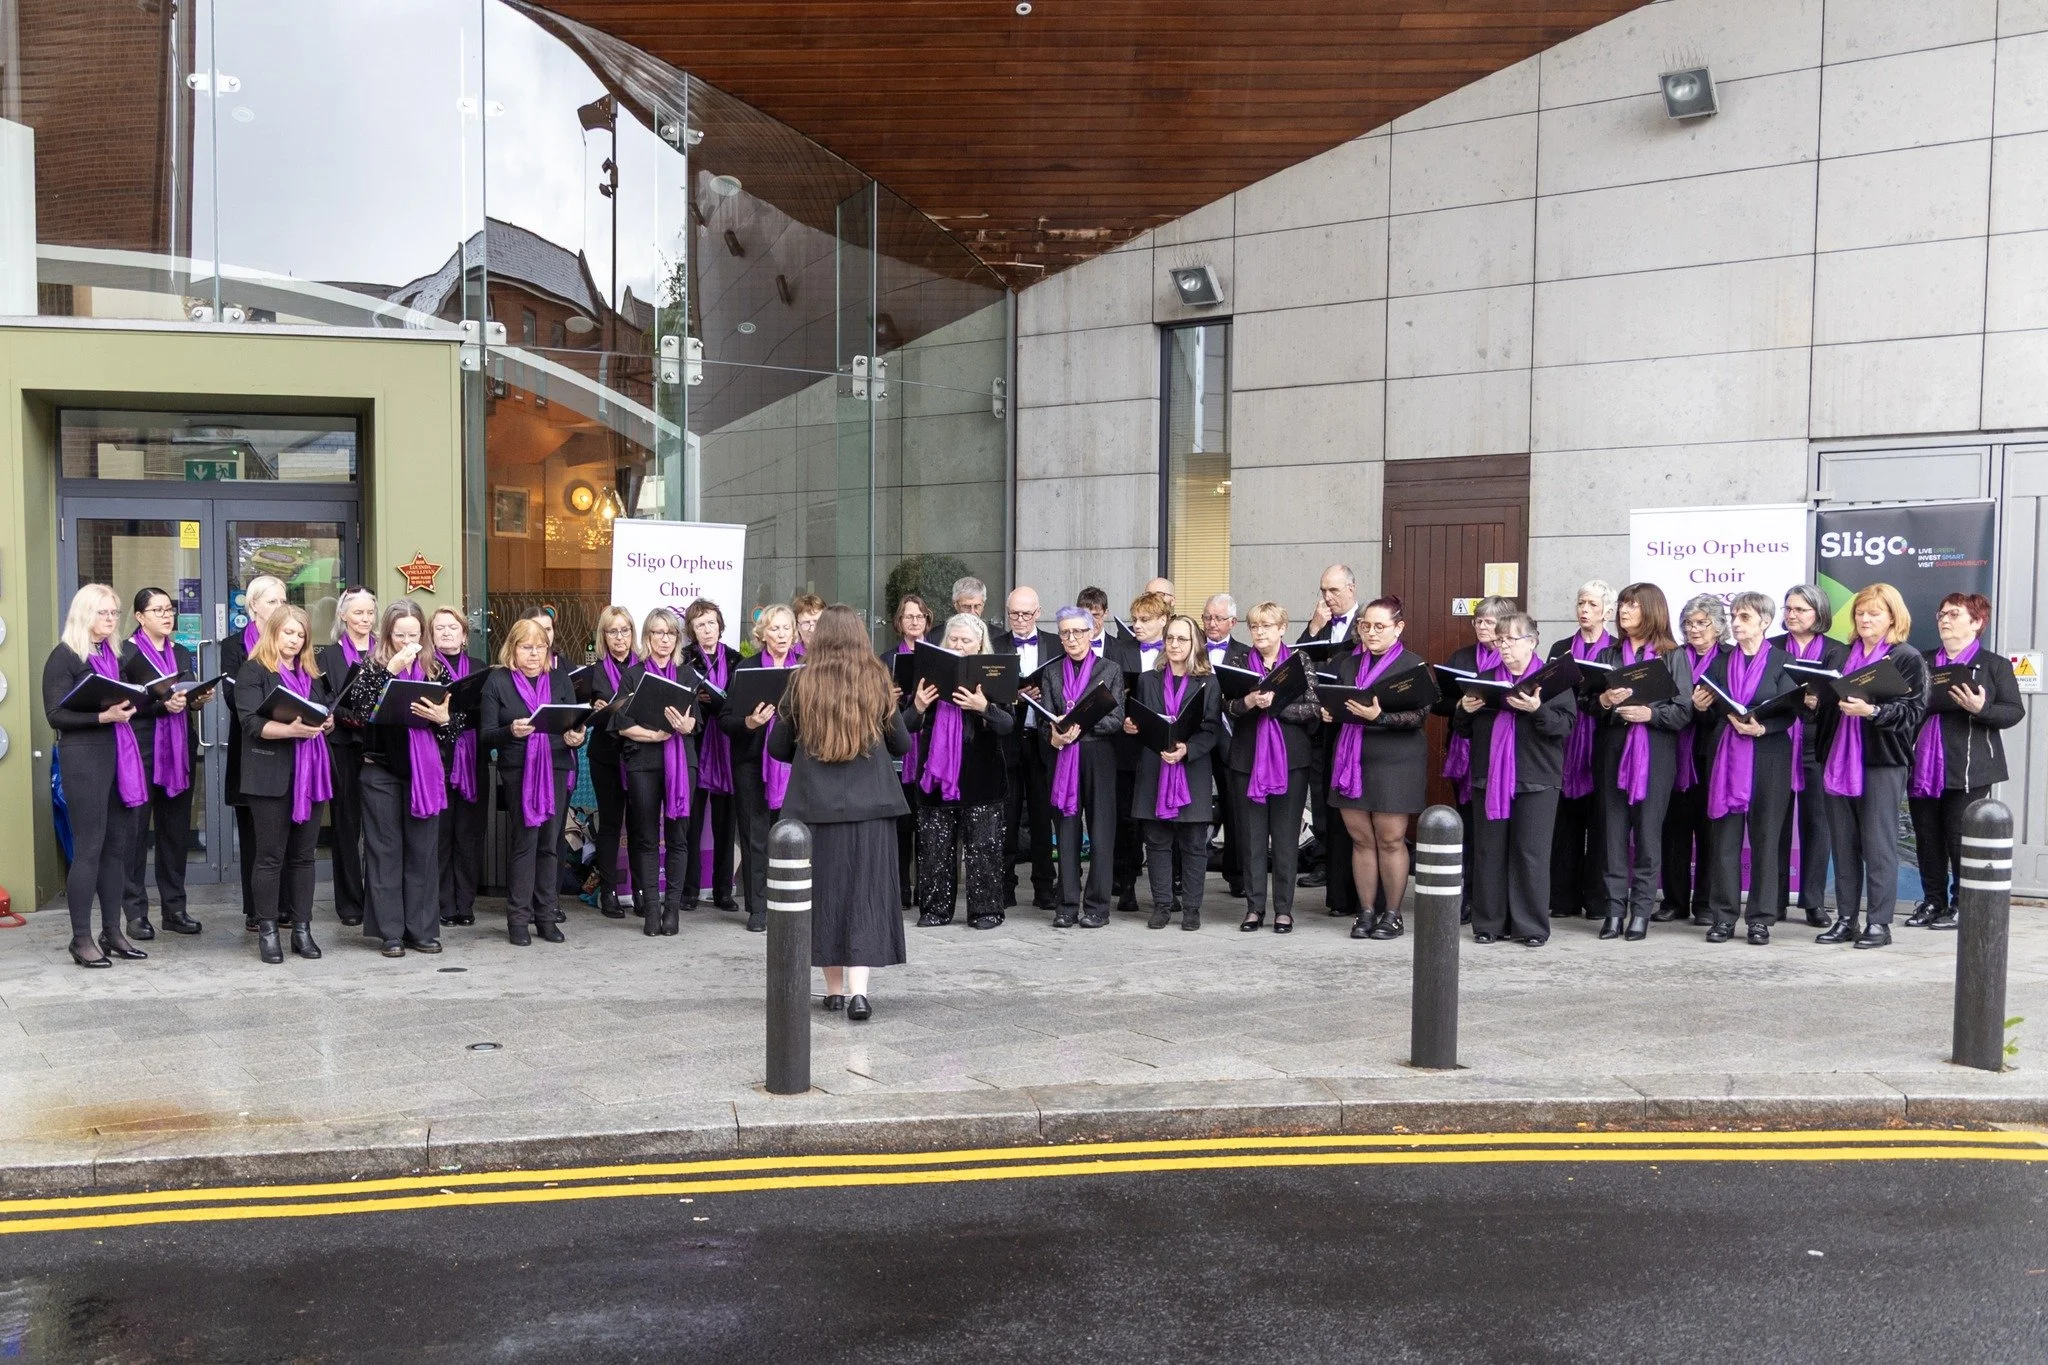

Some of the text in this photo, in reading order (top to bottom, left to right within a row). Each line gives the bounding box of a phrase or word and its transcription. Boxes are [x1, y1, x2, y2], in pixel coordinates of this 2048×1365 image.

[1647, 538, 1790, 560] Sligo Orpheus
[627, 553, 733, 574] Sligo Orpheus
[1936, 559, 1988, 568] SUSTAINABILITY
[1689, 568, 1746, 583] Choir
[659, 582, 701, 597] Choir
